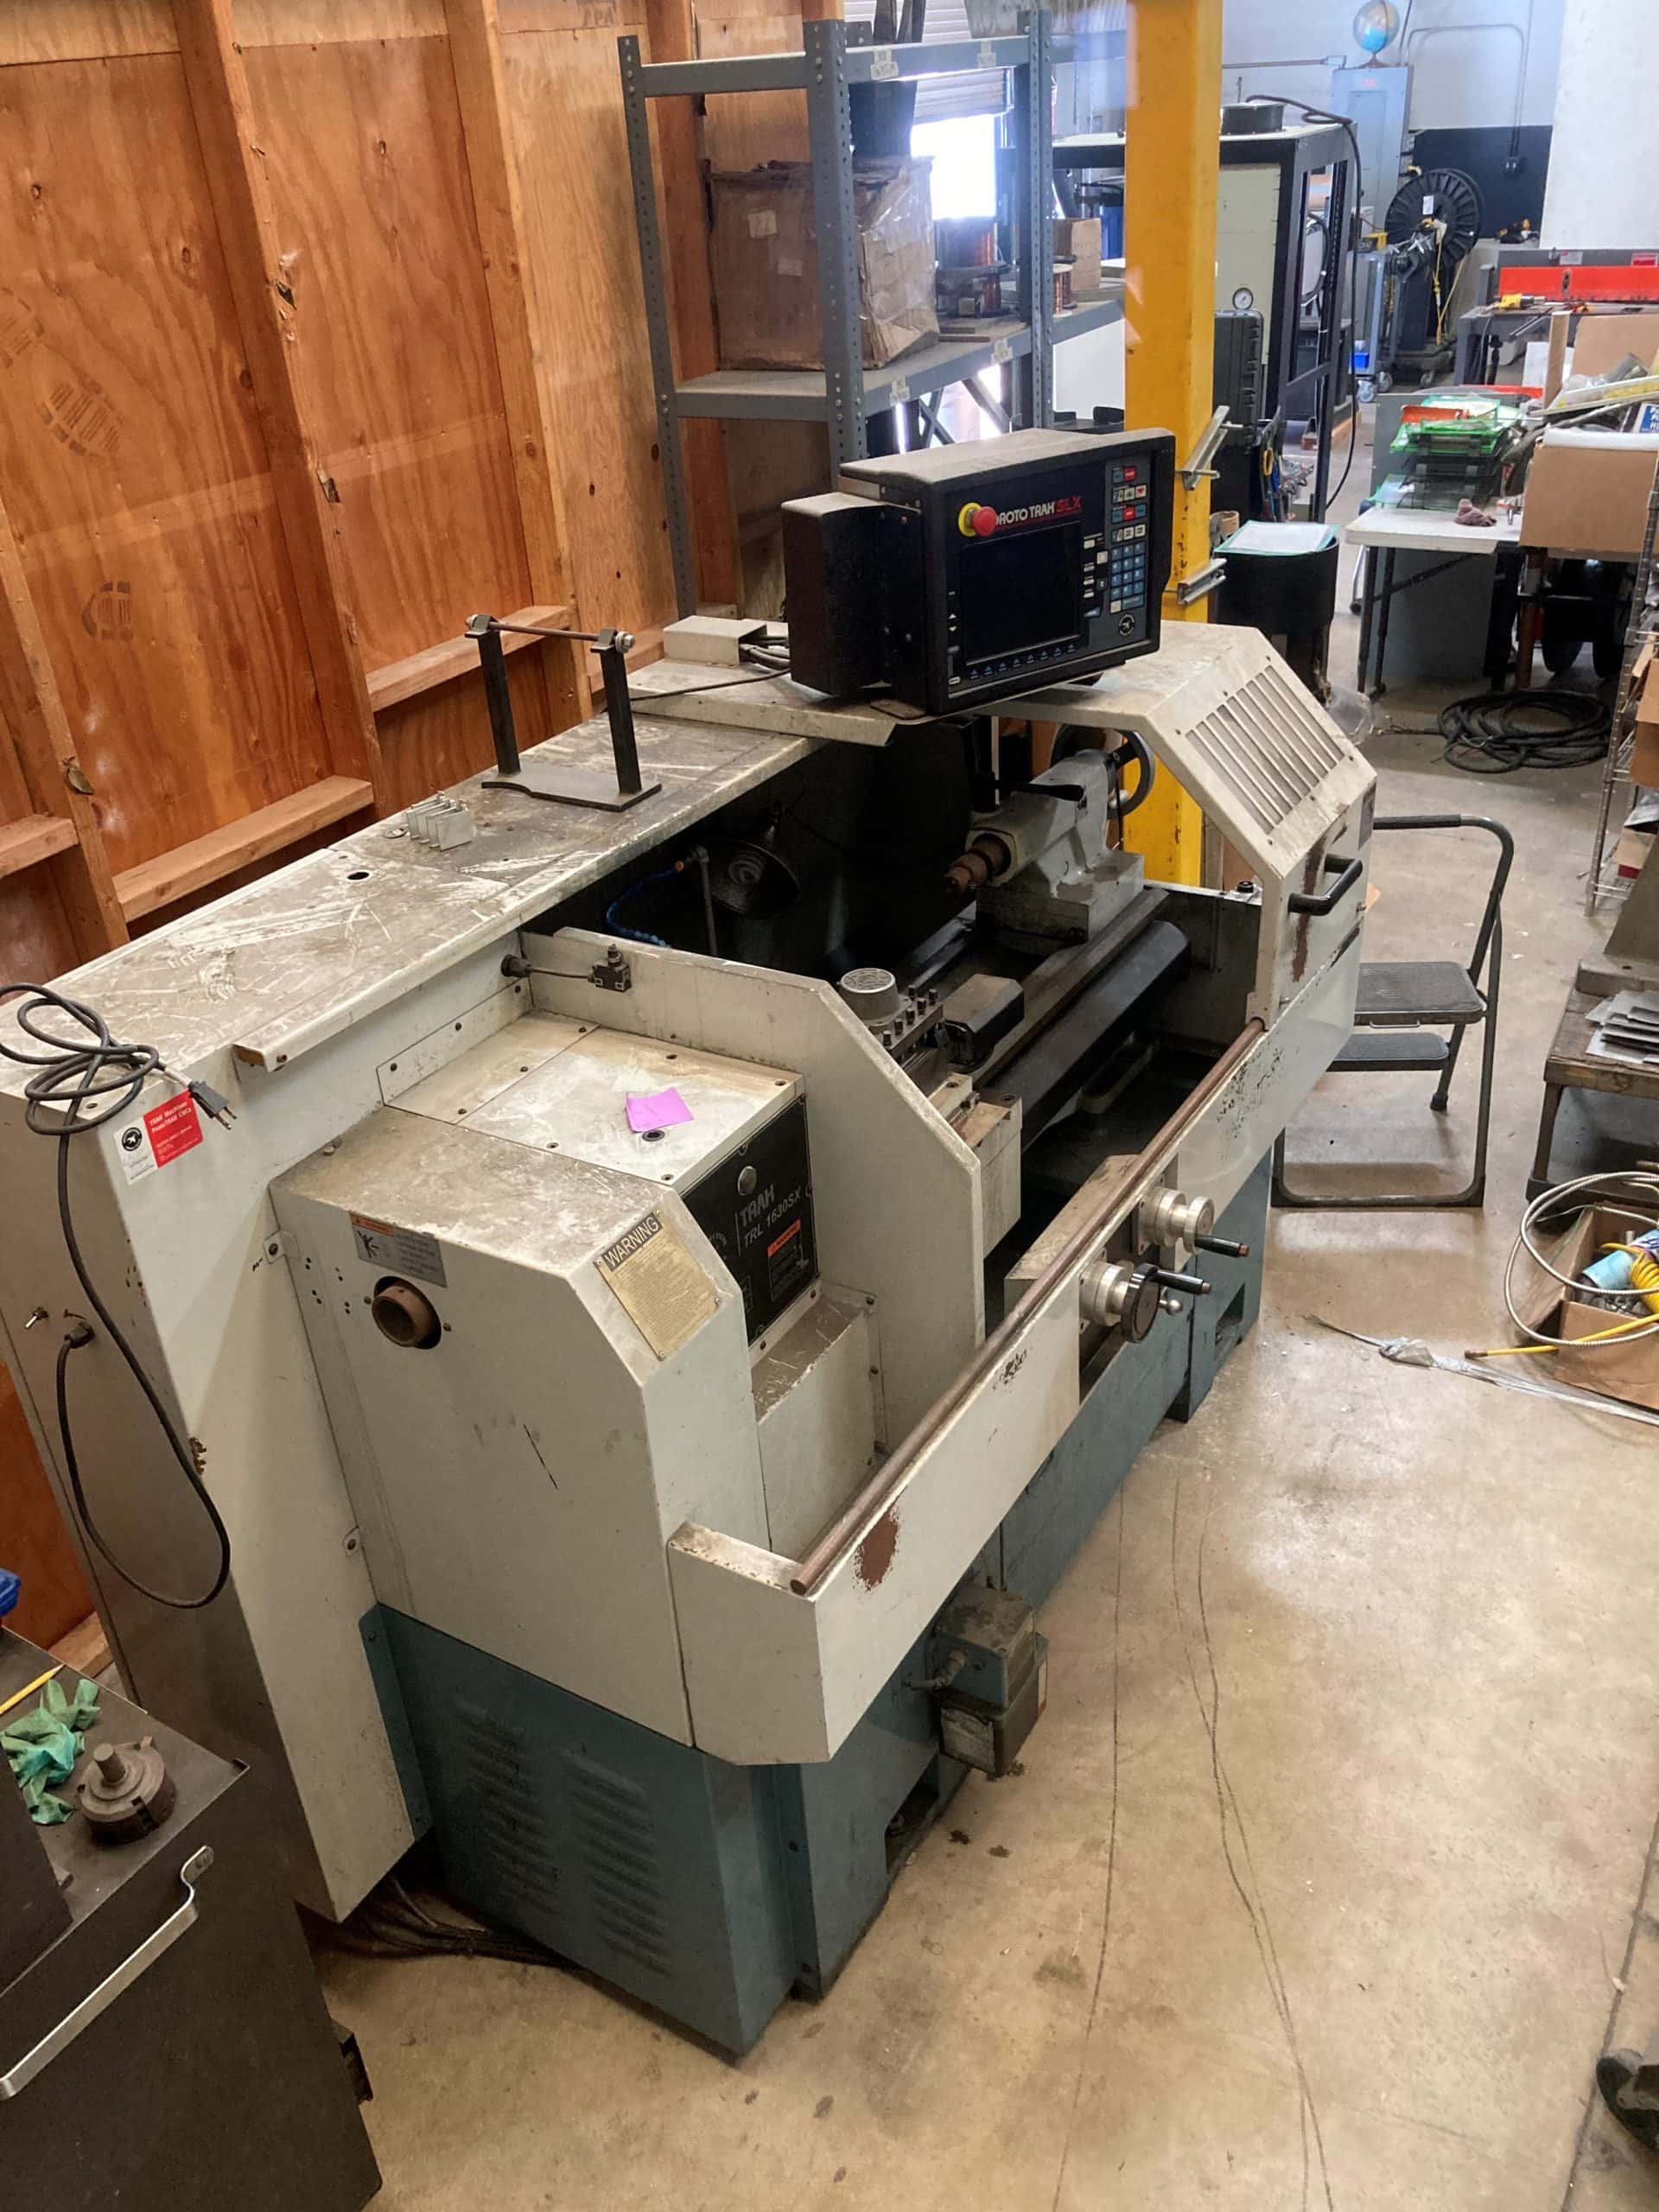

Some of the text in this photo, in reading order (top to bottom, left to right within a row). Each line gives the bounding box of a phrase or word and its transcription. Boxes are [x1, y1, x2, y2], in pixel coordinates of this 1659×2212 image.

[605, 1216, 659, 1268] WARNING
[744, 1226, 763, 1249] TRL
[766, 1185, 801, 1228] 1630SX
